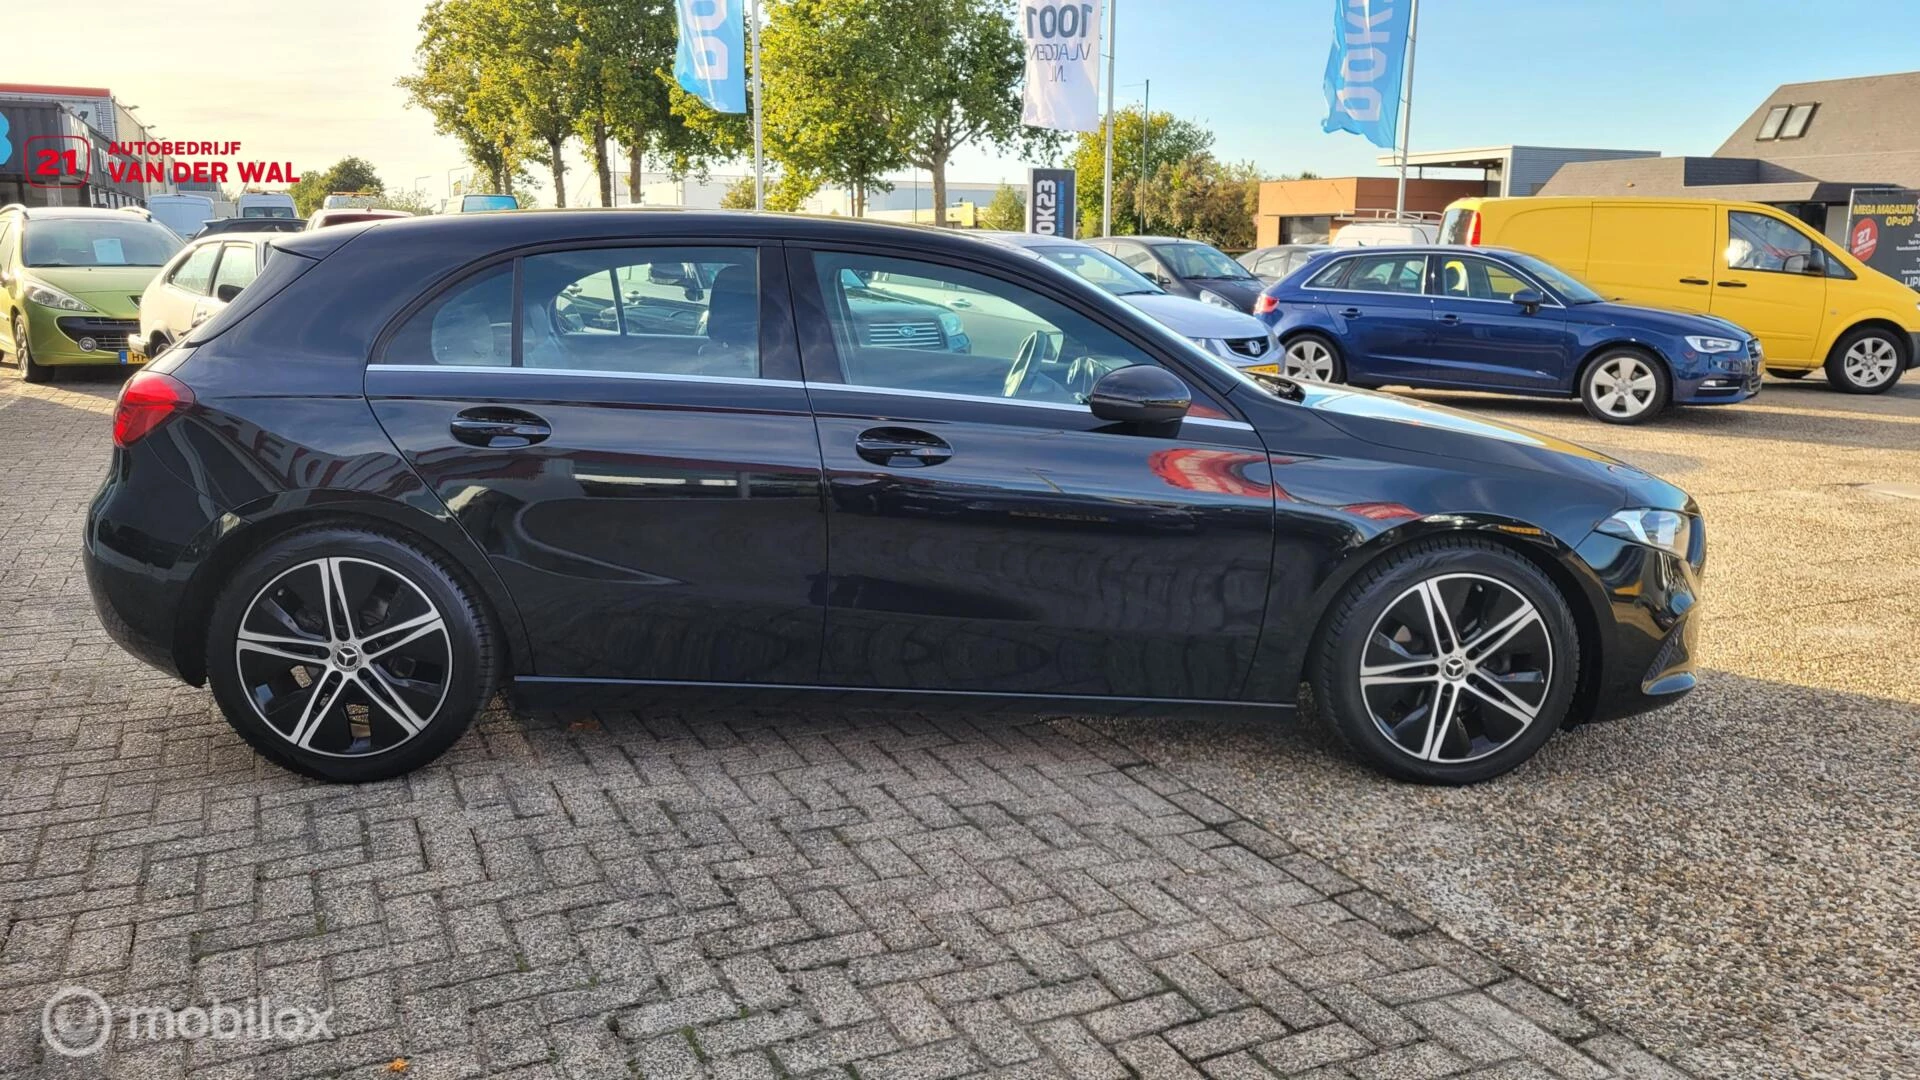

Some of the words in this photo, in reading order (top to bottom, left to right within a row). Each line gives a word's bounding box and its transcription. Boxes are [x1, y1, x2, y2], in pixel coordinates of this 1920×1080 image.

[683, 0, 728, 80] DO
[1335, 0, 1393, 121] DOK
[1036, 179, 1056, 235] OK23
[1853, 204, 1876, 215] MEGA
[1857, 227, 1872, 245] 27
